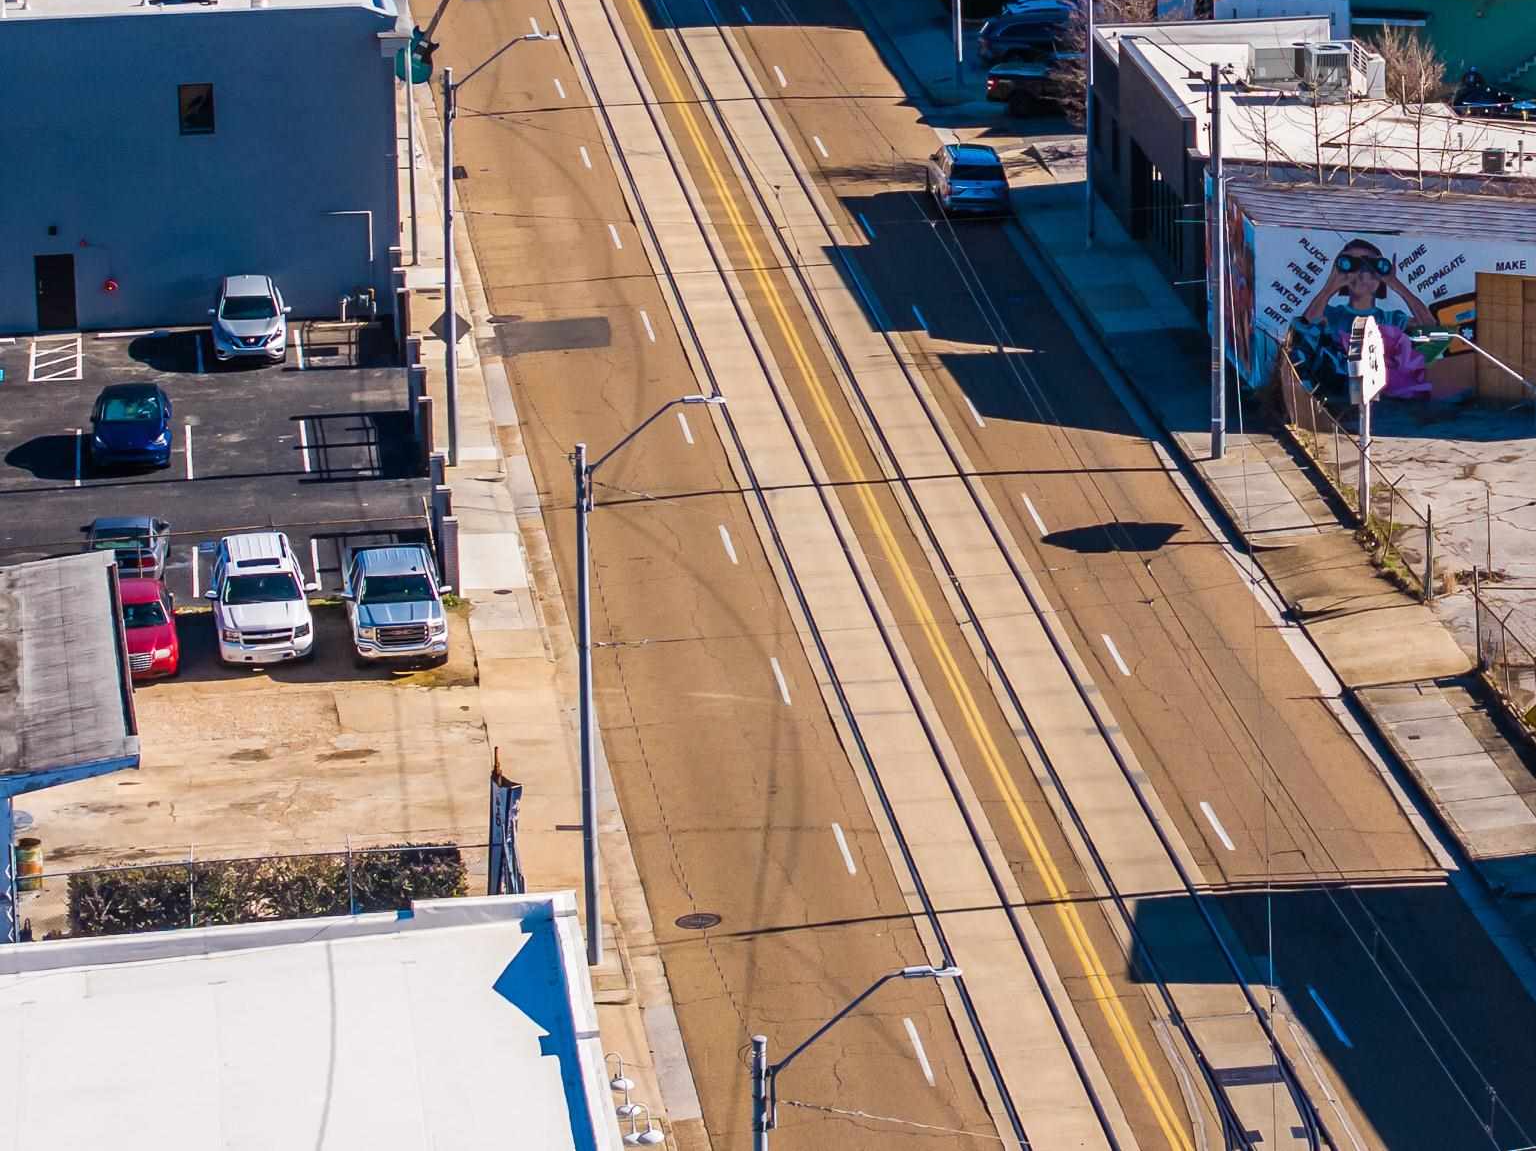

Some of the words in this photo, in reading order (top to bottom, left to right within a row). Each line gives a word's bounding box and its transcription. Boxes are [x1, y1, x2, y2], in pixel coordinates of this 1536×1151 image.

[1299, 237, 1329, 265] PLUCK
[1398, 243, 1427, 272] PRUNE
[1287, 261, 1315, 285] FROM
[1306, 261, 1323, 276] ME
[1408, 264, 1426, 284] AND
[1416, 253, 1467, 293] PROPAGATE
[1495, 260, 1526, 271] MAKE
[1271, 281, 1302, 306] PATCH
[1294, 282, 1311, 296] MY
[1433, 284, 1448, 299] ME
[1263, 306, 1288, 324] DIRT
[1279, 302, 1294, 314] OF
